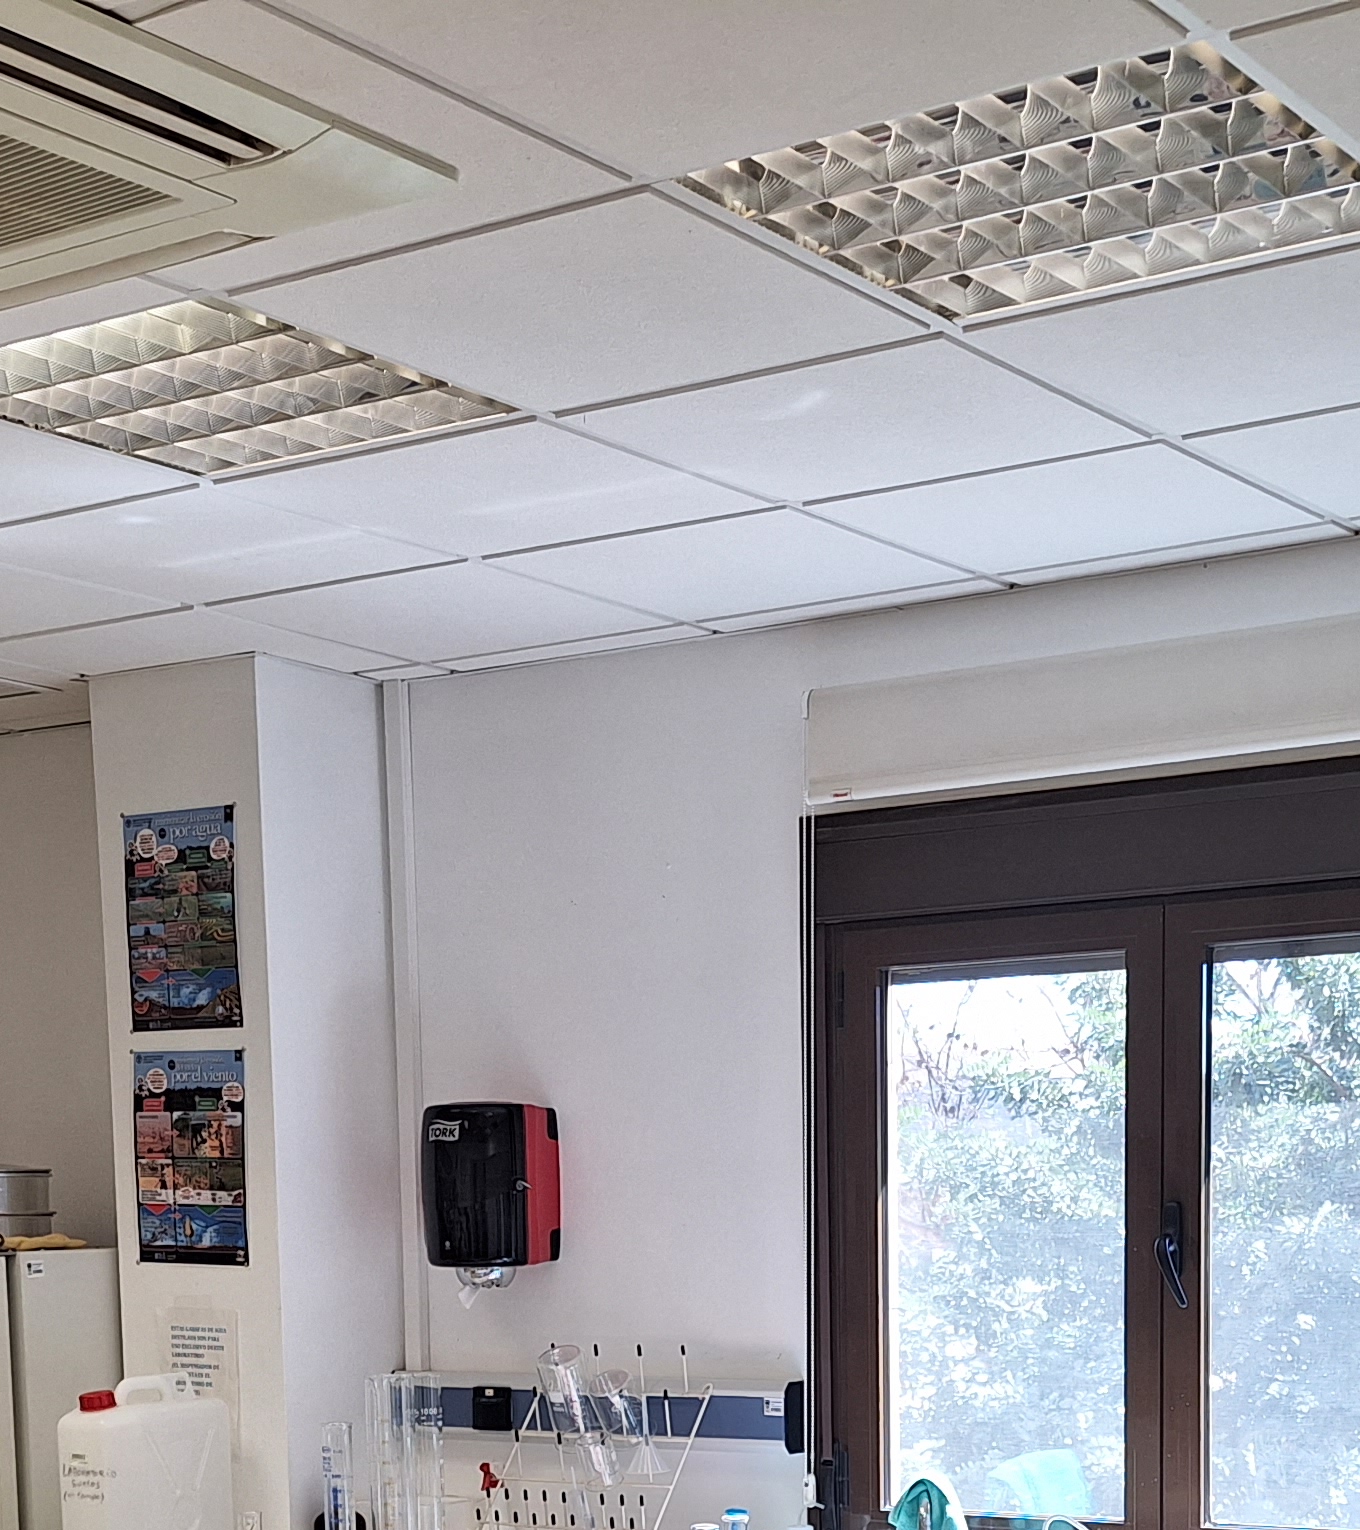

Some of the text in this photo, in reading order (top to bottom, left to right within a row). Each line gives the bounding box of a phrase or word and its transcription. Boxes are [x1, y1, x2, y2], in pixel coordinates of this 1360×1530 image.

[170, 823, 221, 844] por agua
[171, 1072, 191, 1087] por
[203, 1066, 237, 1082] viento
[430, 1127, 457, 1138] TORK
